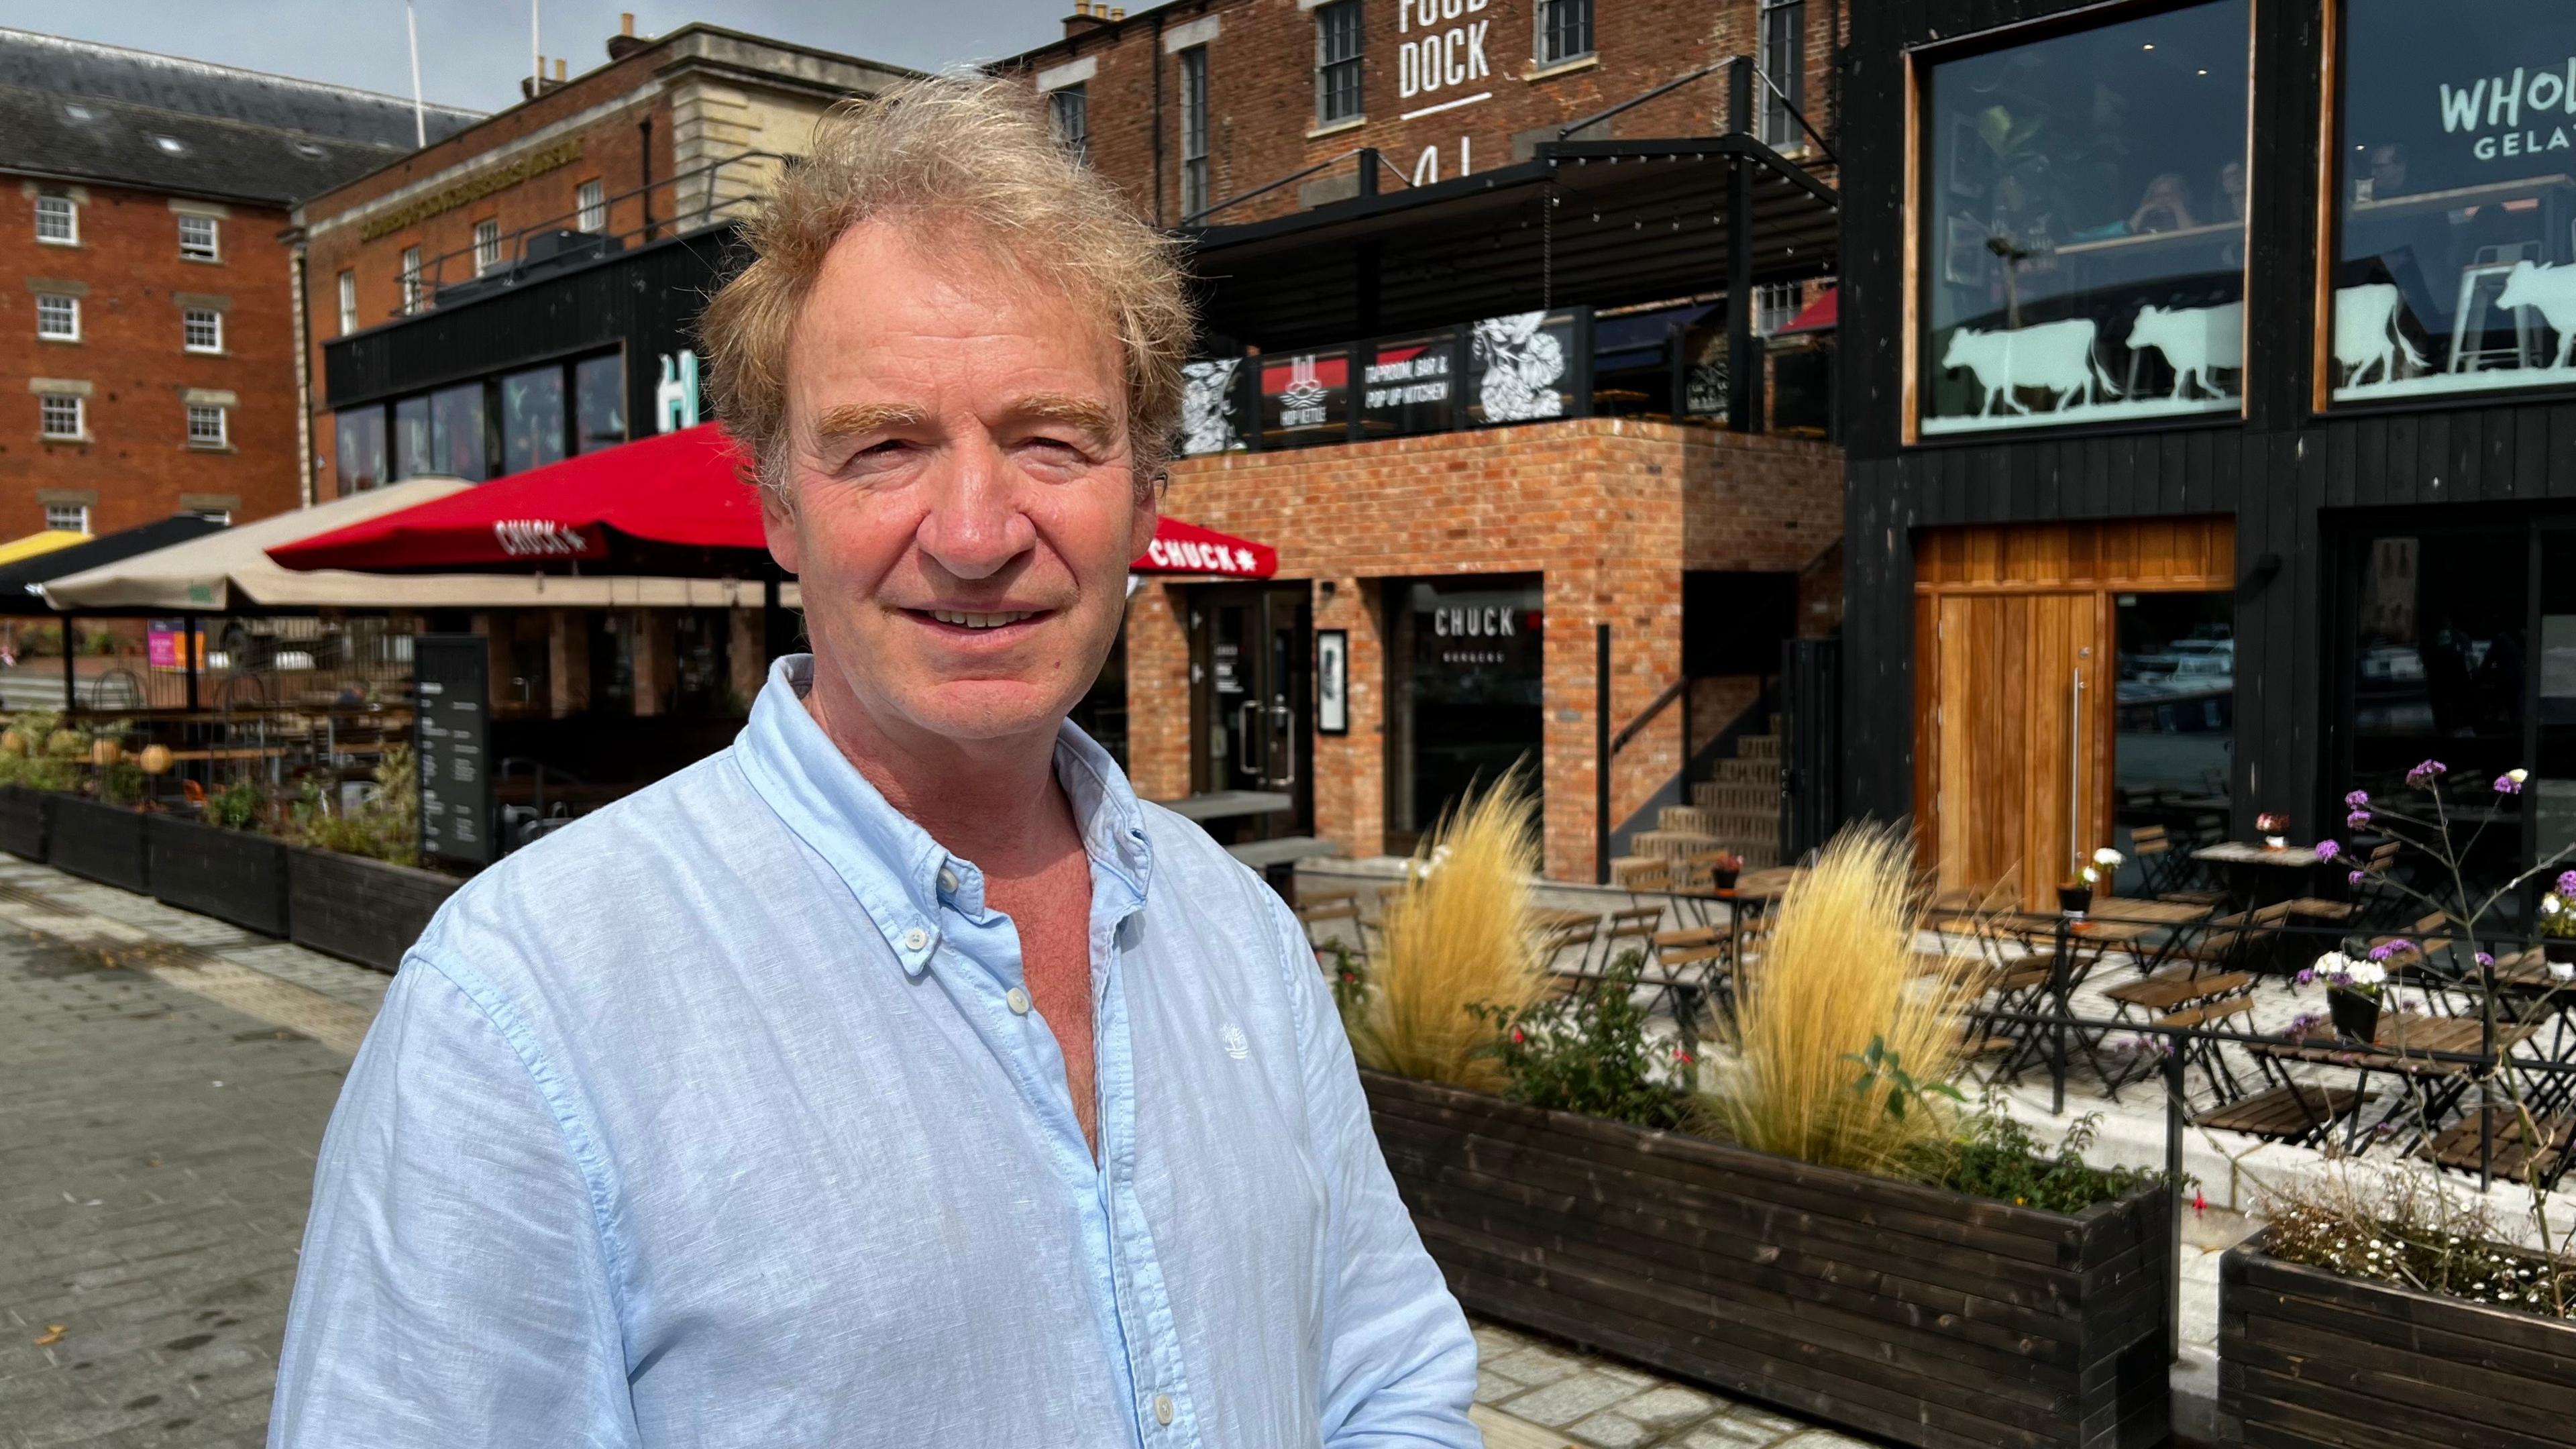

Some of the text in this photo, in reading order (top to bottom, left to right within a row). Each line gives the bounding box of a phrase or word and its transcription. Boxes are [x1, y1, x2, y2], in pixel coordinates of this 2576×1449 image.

[1399, 0, 1489, 33] FO
[1399, 19, 1491, 98] DOCK
[2473, 123, 2576, 160] GELA
[493, 519, 570, 556] CHUCK
[1148, 537, 1237, 572] CHUCK
[1435, 606, 1516, 637] CHUCK
